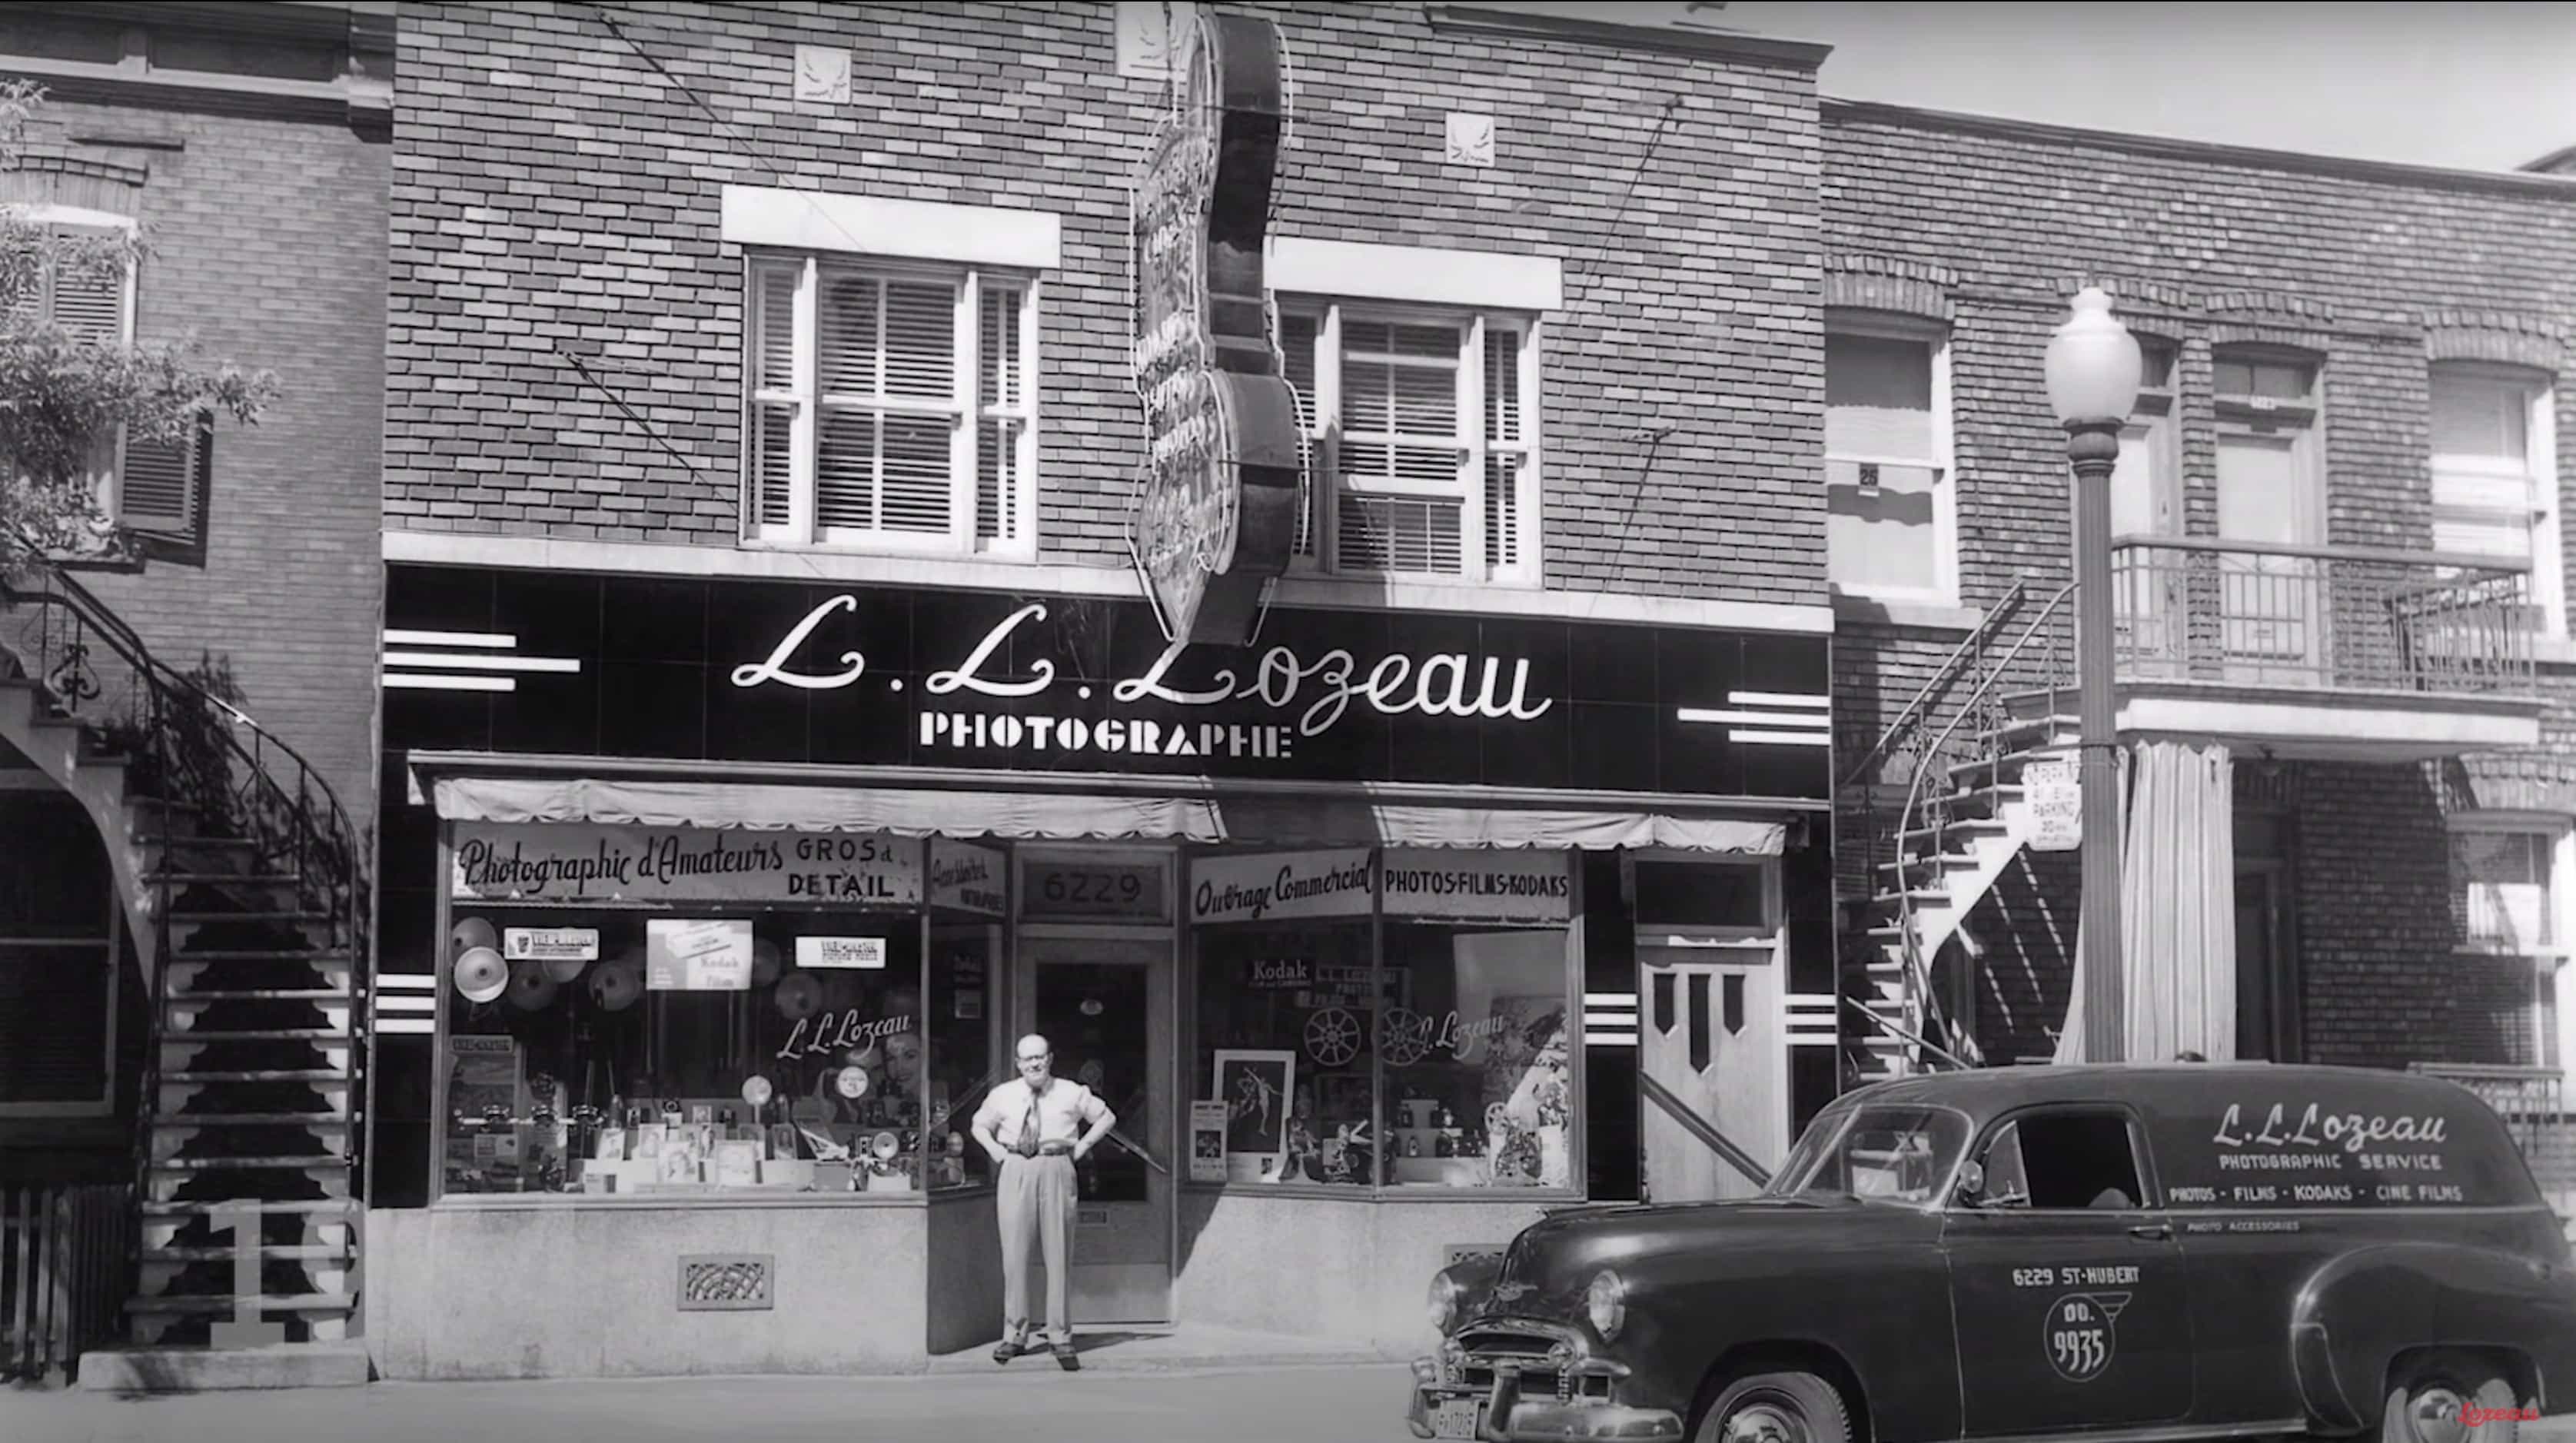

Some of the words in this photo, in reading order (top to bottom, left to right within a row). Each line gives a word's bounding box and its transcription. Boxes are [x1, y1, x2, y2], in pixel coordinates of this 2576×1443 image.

[1112, 637, 1553, 736] Lozeau
[919, 711, 1292, 758] PHOTOGRAPHE
[796, 838, 875, 862] GROS
[788, 874, 895, 898] DETAIL
[1044, 872, 1142, 903] 6229
[1275, 850, 1373, 902] Commercial
[1253, 959, 1308, 980] Kodak
[833, 1008, 910, 1059] Lozeau
[1435, 1010, 1504, 1061] Lozeau
[2213, 1103, 2253, 1146] L.
[2255, 1102, 2291, 1145] L.
[2292, 1102, 2447, 1152] Lozeau
[2219, 1154, 2342, 1169] PHOTOGRAPHIC
[2359, 1155, 2443, 1170] SERVICE
[2169, 1187, 2215, 1202] PHOTOS
[2234, 1186, 2277, 1201] FILMS
[2294, 1186, 2352, 1201] KODAKS
[2376, 1185, 2411, 1200] CINE
[2418, 1185, 2463, 1201] FILMS
[2187, 1221, 2222, 1232] PHOTO
[2229, 1220, 2300, 1232] ACCESSORIES
[2013, 1268, 2054, 1286] 6229
[2054, 1329, 2105, 1374] 9935
